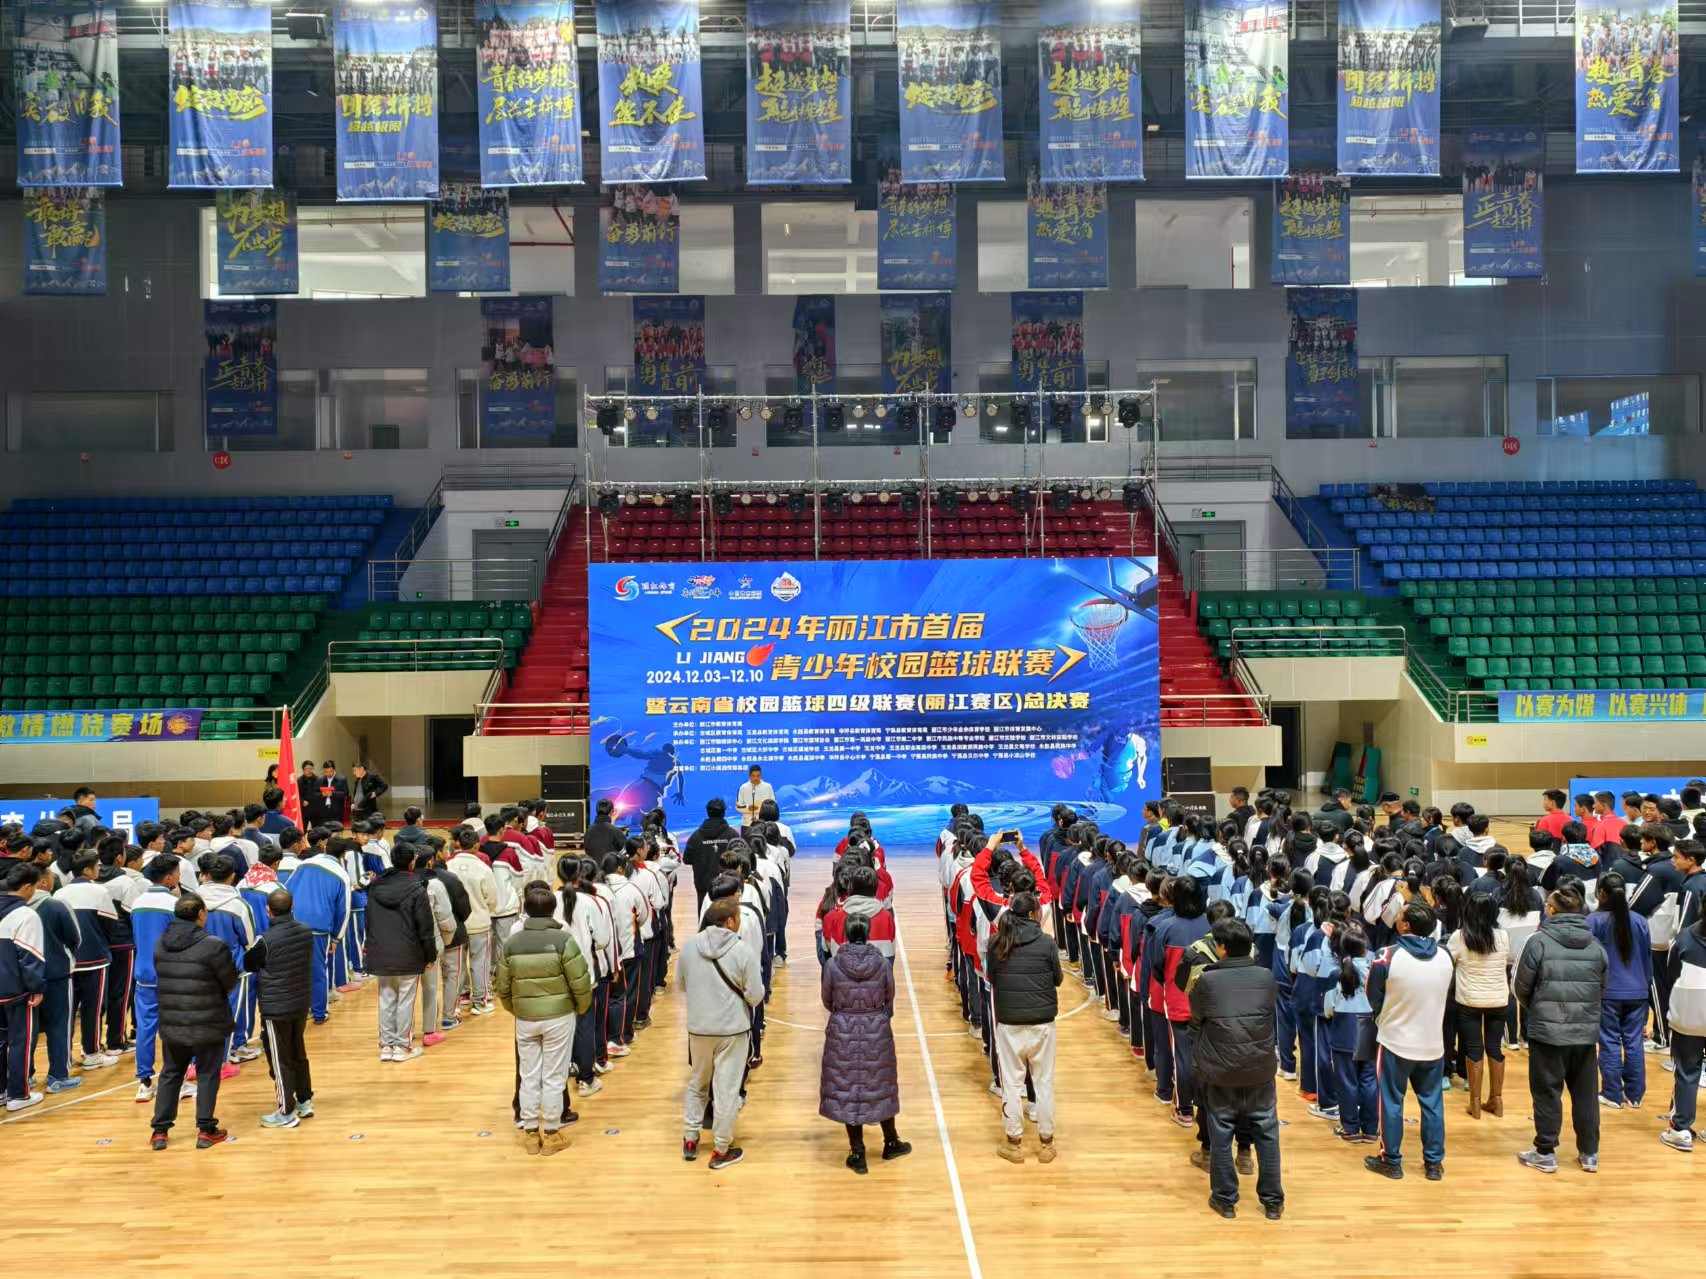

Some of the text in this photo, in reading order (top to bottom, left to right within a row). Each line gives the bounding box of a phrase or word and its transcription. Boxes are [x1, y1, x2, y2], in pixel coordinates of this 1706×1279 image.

[480, 64, 577, 93] 青春的梦想
[755, 62, 840, 98] 超越梦想
[1048, 61, 1131, 98] 超越梦想
[755, 96, 845, 124] 再创辉煌
[1048, 95, 1135, 122] 再创辉煌
[1350, 95, 1406, 109] 超越极限
[348, 120, 402, 134] 超越极限
[1280, 192, 1341, 221] 超越梦想
[1474, 190, 1540, 219] 正青春
[606, 222, 677, 245] 奋勇前行
[1280, 219, 1344, 241] 再创辉煌
[213, 353, 273, 381] 正青春
[689, 613, 985, 642] 2024年丽江市首届
[676, 651, 745, 664] LI JIANG
[771, 649, 1056, 681] 青少年校园篮球联赛
[647, 669, 763, 684] 2024.12.03-12.10
[645, 692, 1090, 714] 暨云南省校园篮球四级联赛(丽江赛区)总决赛
